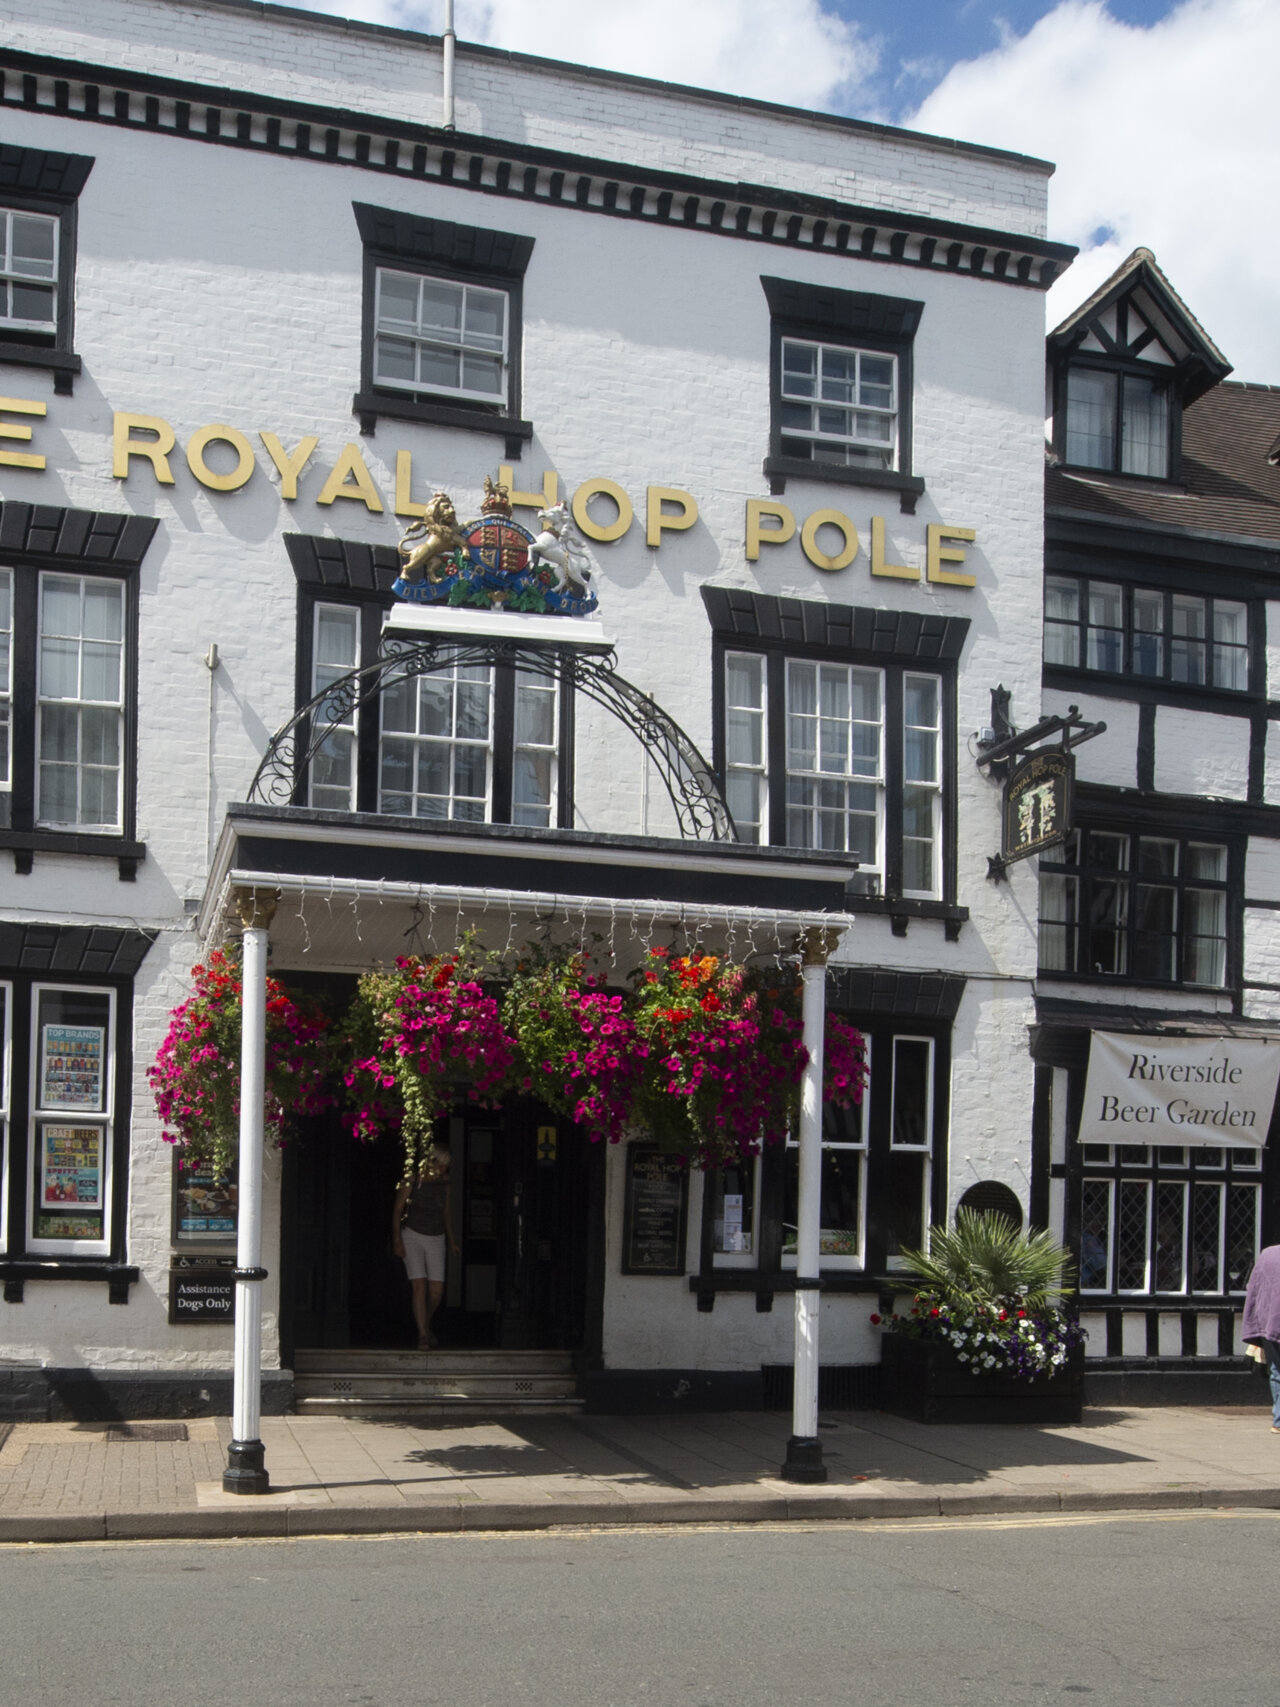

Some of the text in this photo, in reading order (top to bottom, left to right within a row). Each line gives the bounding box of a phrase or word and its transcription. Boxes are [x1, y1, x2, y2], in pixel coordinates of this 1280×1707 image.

[112, 411, 427, 518] ROYAL
[497, 465, 699, 549] HOP
[744, 499, 977, 588] POLE
[1009, 763, 1067, 801] ROYAL HOP POLE
[48, 1028, 100, 1039] TOP BRANDS
[1128, 1053, 1242, 1084] Riverside
[1099, 1095, 1256, 1127] Beer Garden
[47, 1128, 99, 1139] CRAFT BEERS
[178, 1284, 231, 1294] Assistance
[177, 1298, 231, 1312] Dogs Only
